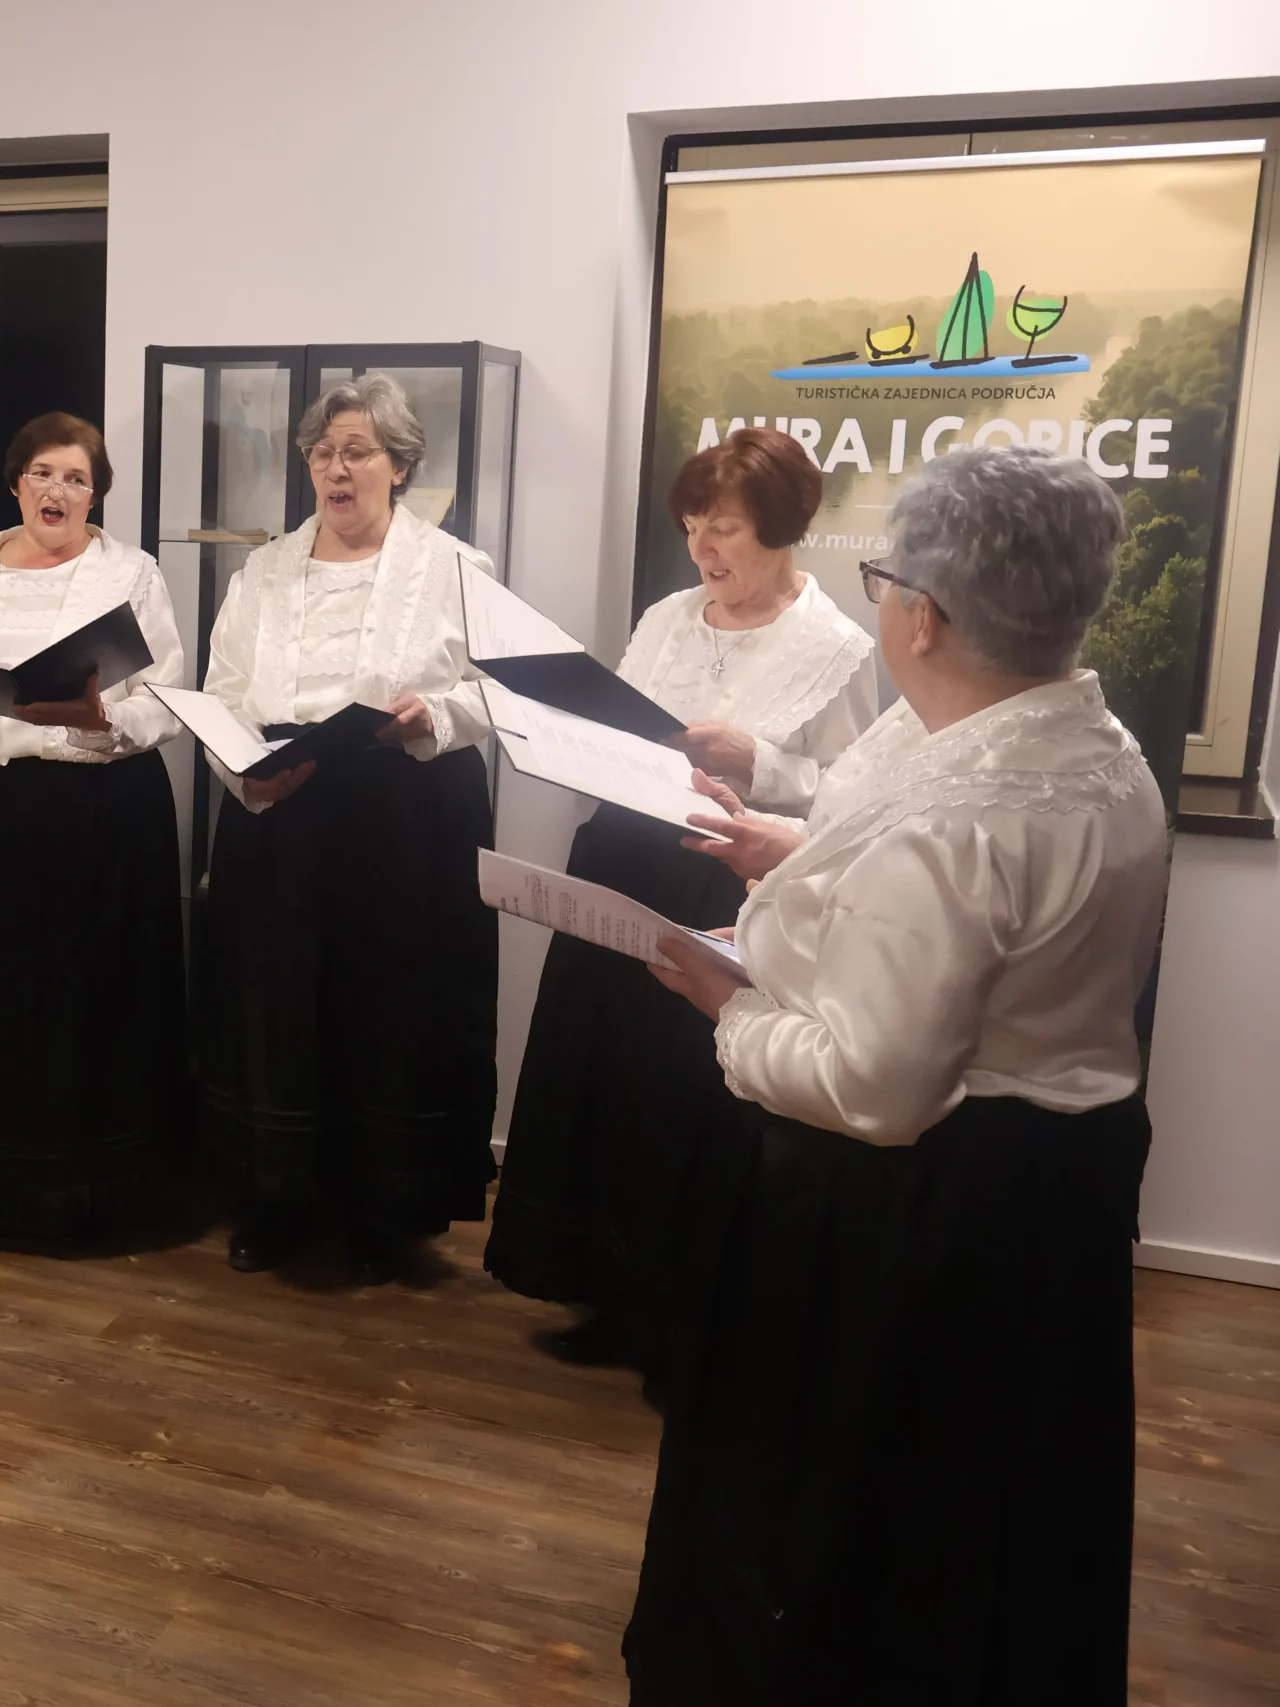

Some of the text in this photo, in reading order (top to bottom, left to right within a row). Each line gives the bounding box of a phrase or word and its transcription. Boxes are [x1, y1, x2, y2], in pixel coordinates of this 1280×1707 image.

[796, 384, 1056, 401] TURISTIČKA ZAJEDNICA PODRUČJA
[697, 416, 872, 473] MRA
[888, 419, 907, 474] I
